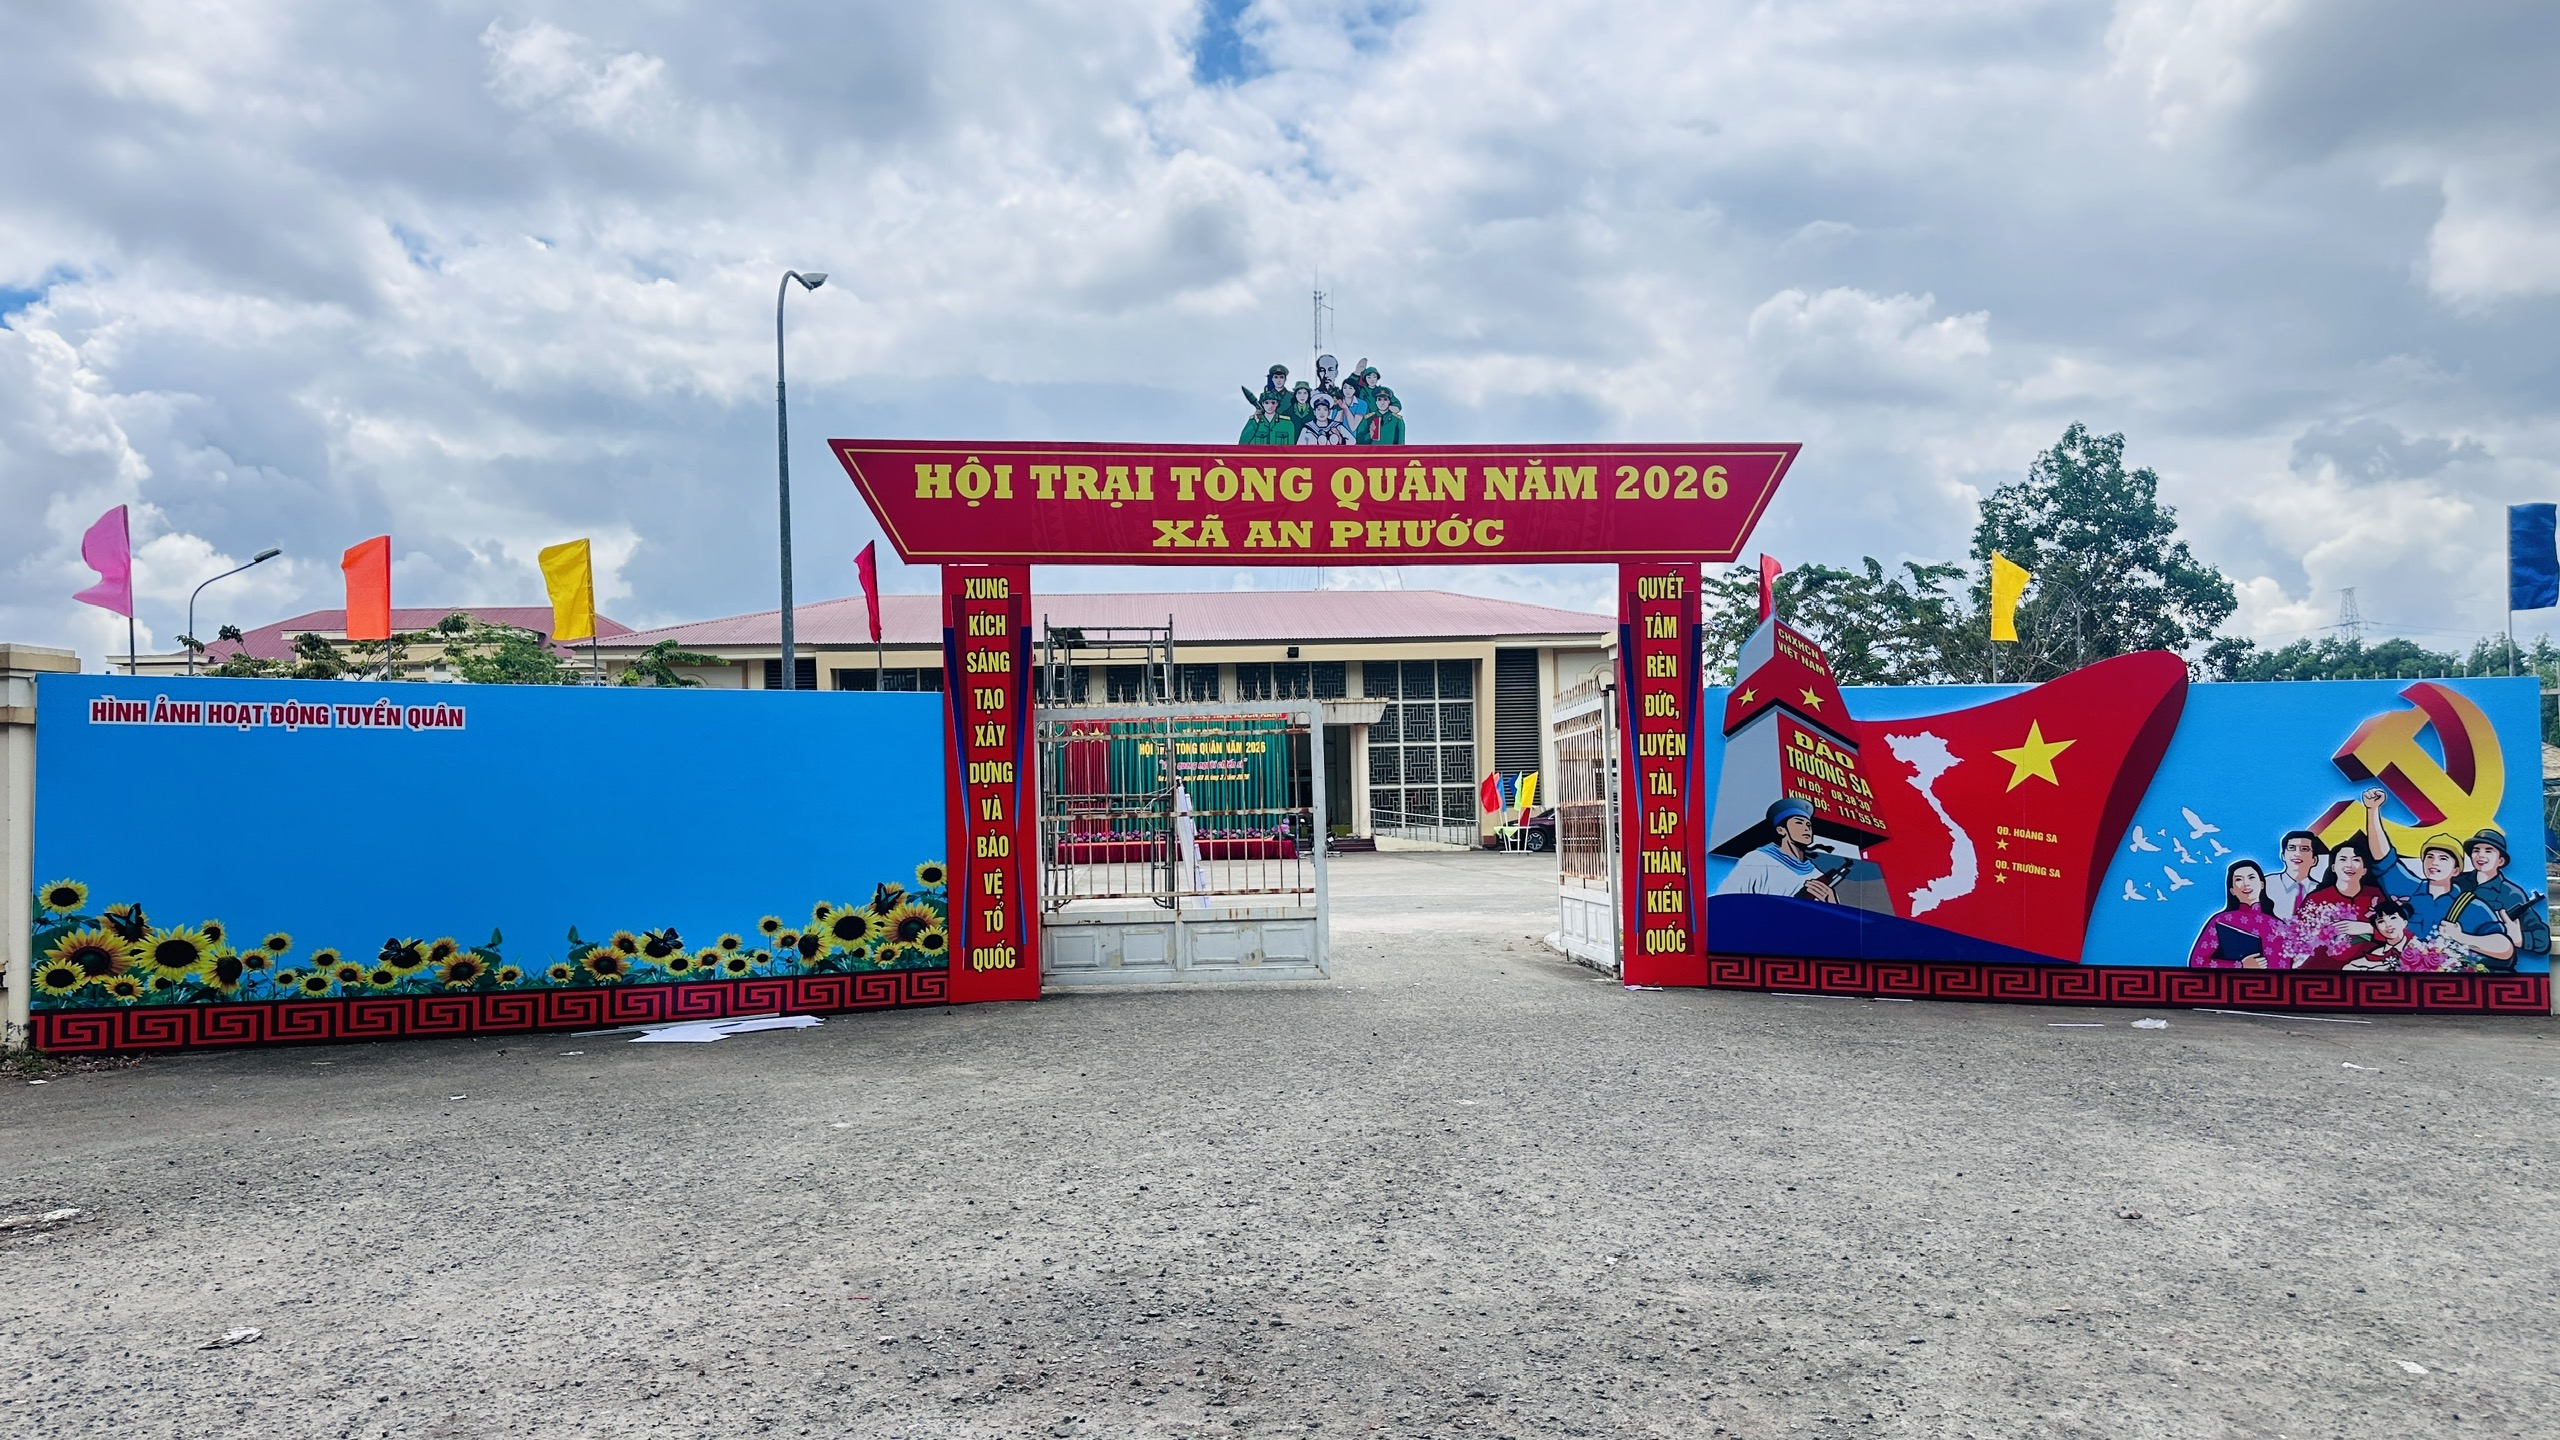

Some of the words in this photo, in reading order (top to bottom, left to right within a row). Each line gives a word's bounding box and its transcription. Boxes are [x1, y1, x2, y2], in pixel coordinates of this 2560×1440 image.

[915, 457, 1013, 507] HỘI
[1030, 465, 1154, 508] TRẠI
[1170, 458, 1313, 502] TÒNG
[1330, 460, 1468, 511] QUÂN
[1483, 459, 1598, 501] NĂM
[1615, 465, 1728, 500] 2026
[1152, 514, 1230, 548] XÃ
[1244, 520, 1313, 549] AN
[1330, 514, 1504, 549] PHƯỚC
[964, 577, 1009, 599] XUNG
[1638, 570, 1684, 601] QUYẾT
[968, 611, 1006, 636] KÍCH
[1645, 612, 1677, 639] TÂM
[1777, 640, 1798, 660] VIỆT
[1801, 655, 1826, 676] NAM
[1778, 628, 1819, 660] CHXHCN
[966, 648, 1011, 673] SÁNG
[1646, 651, 1677, 677] RÈN
[92, 698, 147, 722] HÌNH
[154, 696, 201, 723] ẢNH
[208, 704, 264, 728] HOẠT
[270, 702, 329, 729] ĐỘNG
[335, 700, 400, 726] TUYỂN
[408, 704, 463, 727] QUÂN
[974, 688, 1005, 714] TẠO
[1645, 690, 1680, 720] ĐỨC,
[974, 721, 1006, 747] XÂY
[1246, 741, 1266, 754] 2026
[1639, 729, 1686, 760] LUYỆN
[1794, 730, 1854, 769] ĐẢO
[969, 760, 1013, 788] DỰNG
[1649, 767, 1677, 797] TÀI,
[1849, 773, 1874, 799] SA
[981, 795, 1003, 820] VÀ
[1649, 807, 1678, 839] LẬP
[2014, 828, 2043, 841] HOÀNG
[2046, 834, 2058, 843] SA
[977, 829, 1009, 858] BẢO
[1642, 846, 1686, 876] THÂN,
[2049, 869, 2061, 878] SA
[983, 868, 1003, 899] VỆ
[1647, 883, 1683, 913] KIẾN
[983, 902, 1004, 932] TỔ
[1645, 921, 1686, 955] QUỐC
[972, 940, 1015, 972] QUỐC
